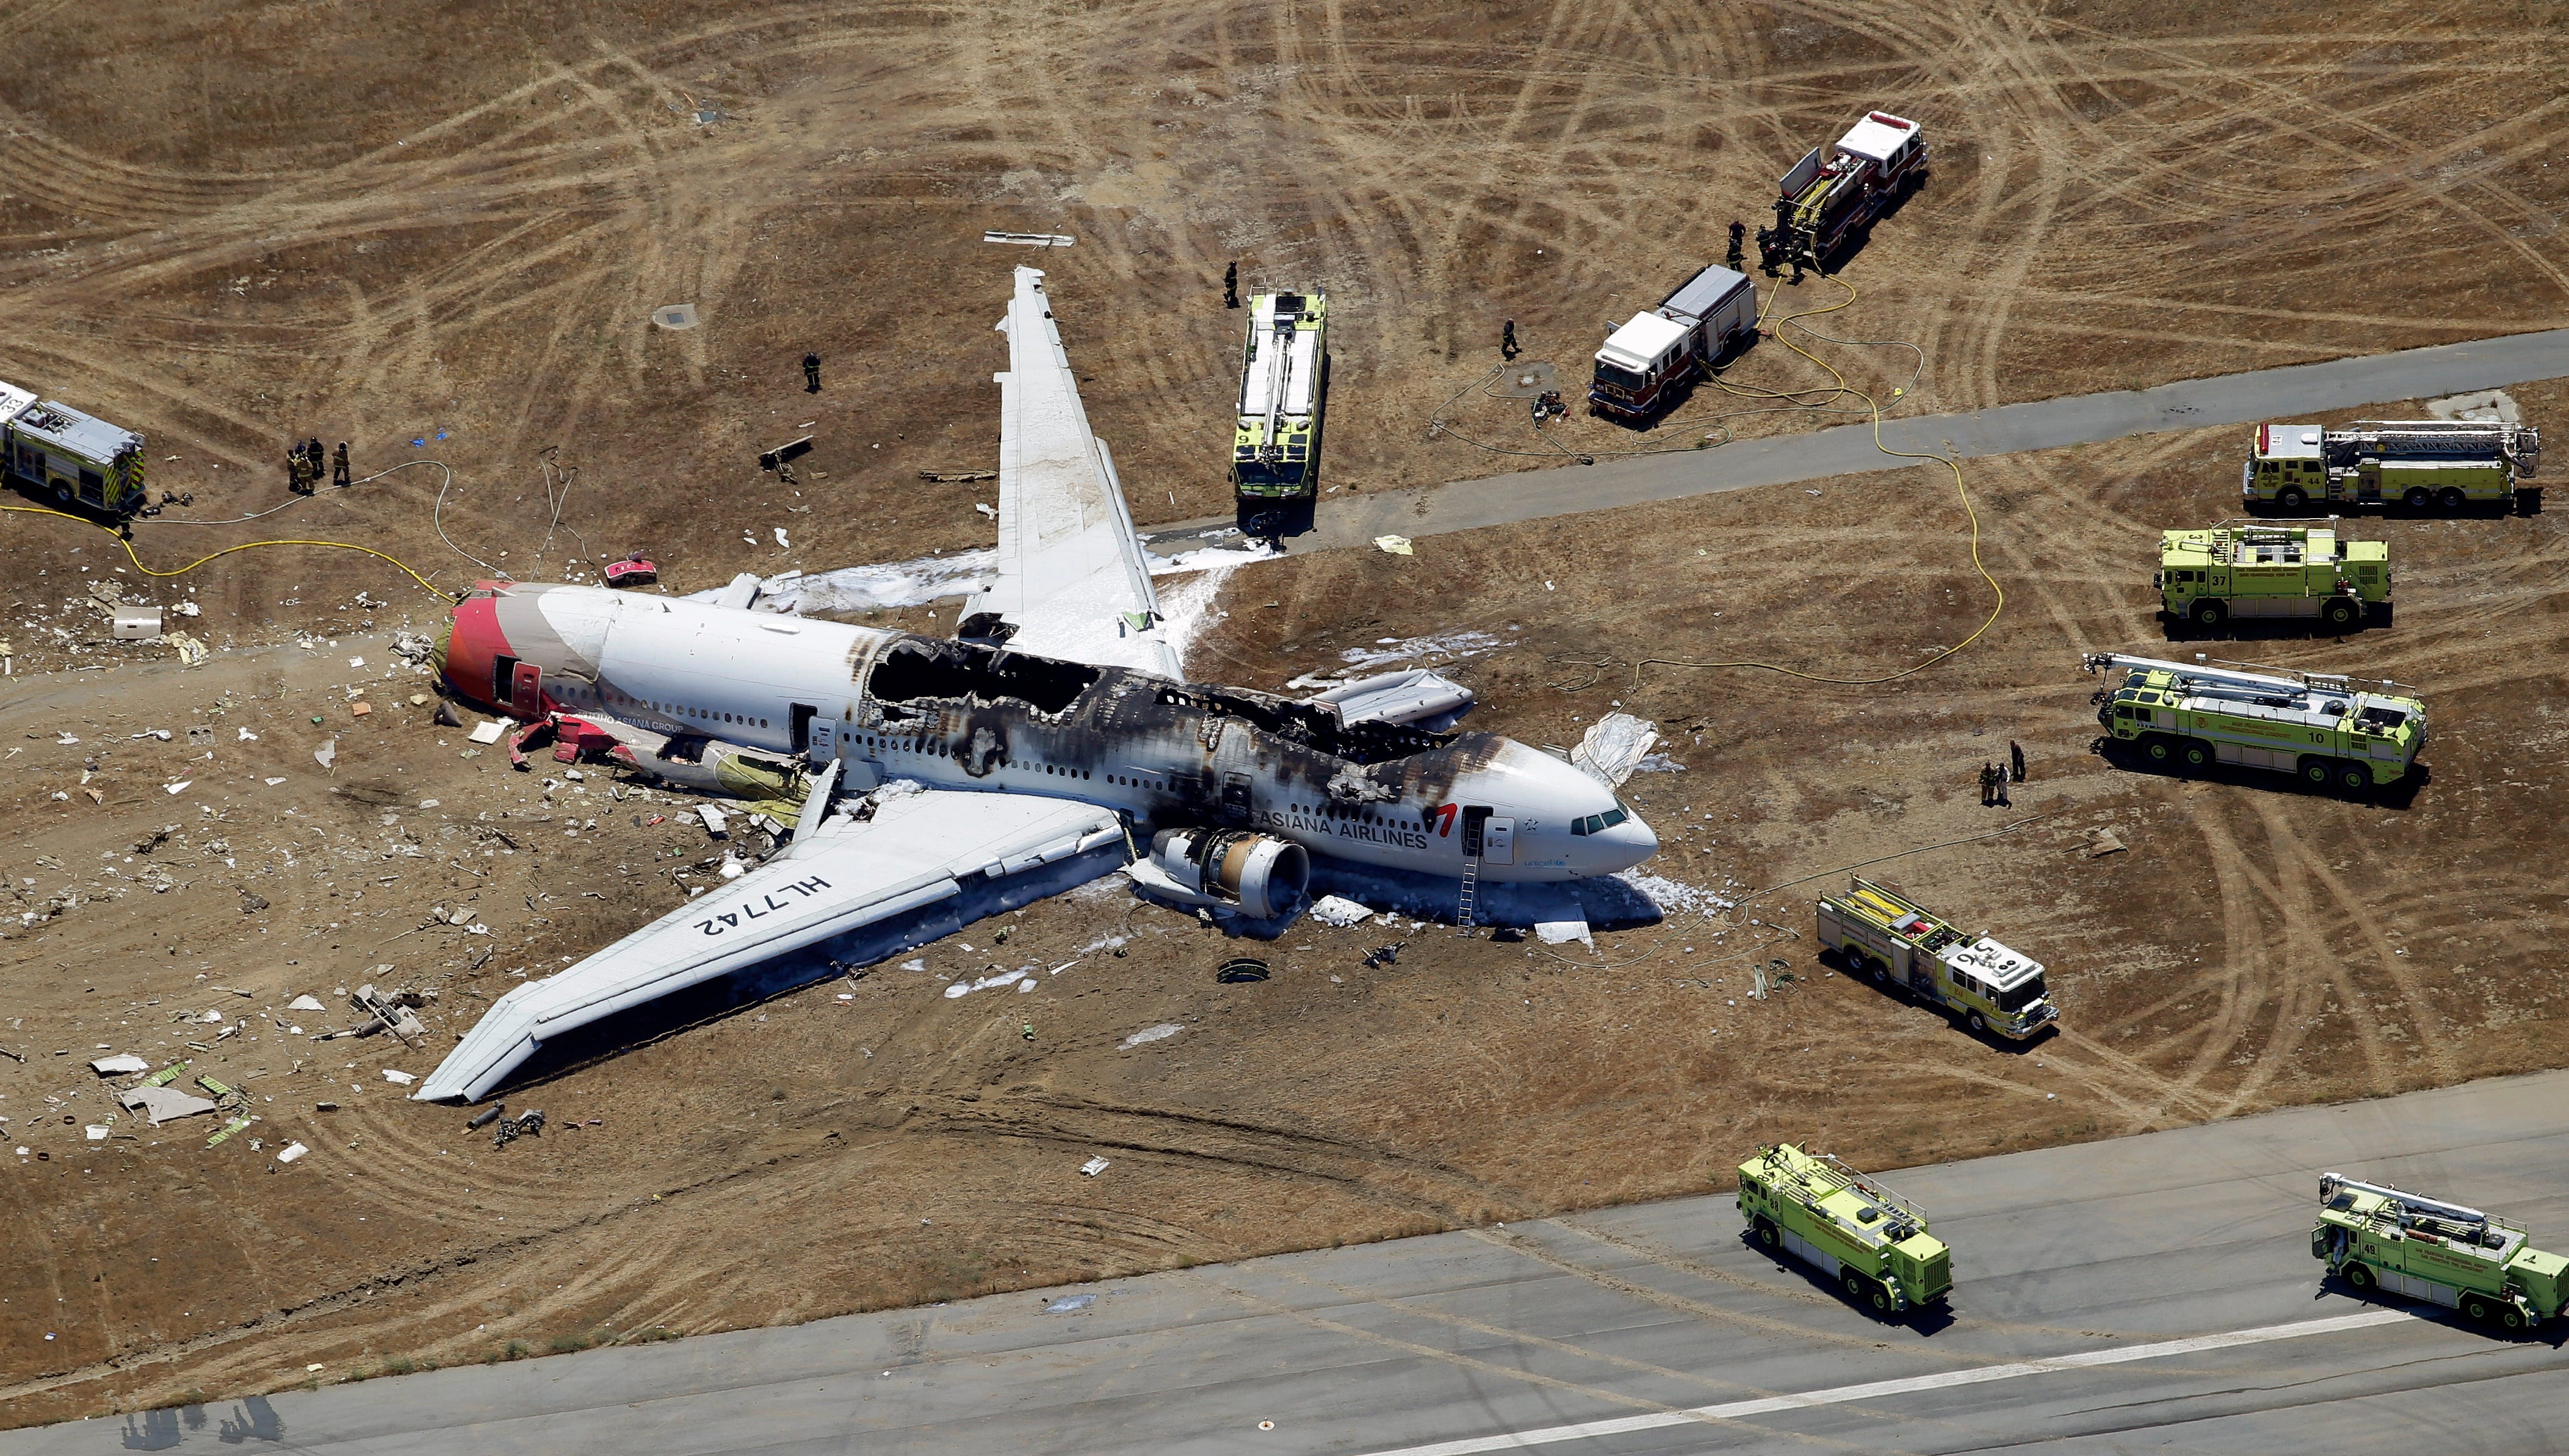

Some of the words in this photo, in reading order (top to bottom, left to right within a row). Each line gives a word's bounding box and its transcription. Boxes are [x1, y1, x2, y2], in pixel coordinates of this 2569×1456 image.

[1, 399, 23, 413] 33
[1238, 435, 1249, 444] 9
[2212, 576, 2226, 586] 37
[651, 721, 684, 733] GROUP
[2308, 732, 2324, 743] 10
[1260, 810, 1332, 835] ASIANA
[1339, 823, 1428, 849] AIRLINES
[693, 876, 832, 935] HL7742
[1770, 1198, 1779, 1211] 88
[2365, 1244, 2375, 1255] 49
